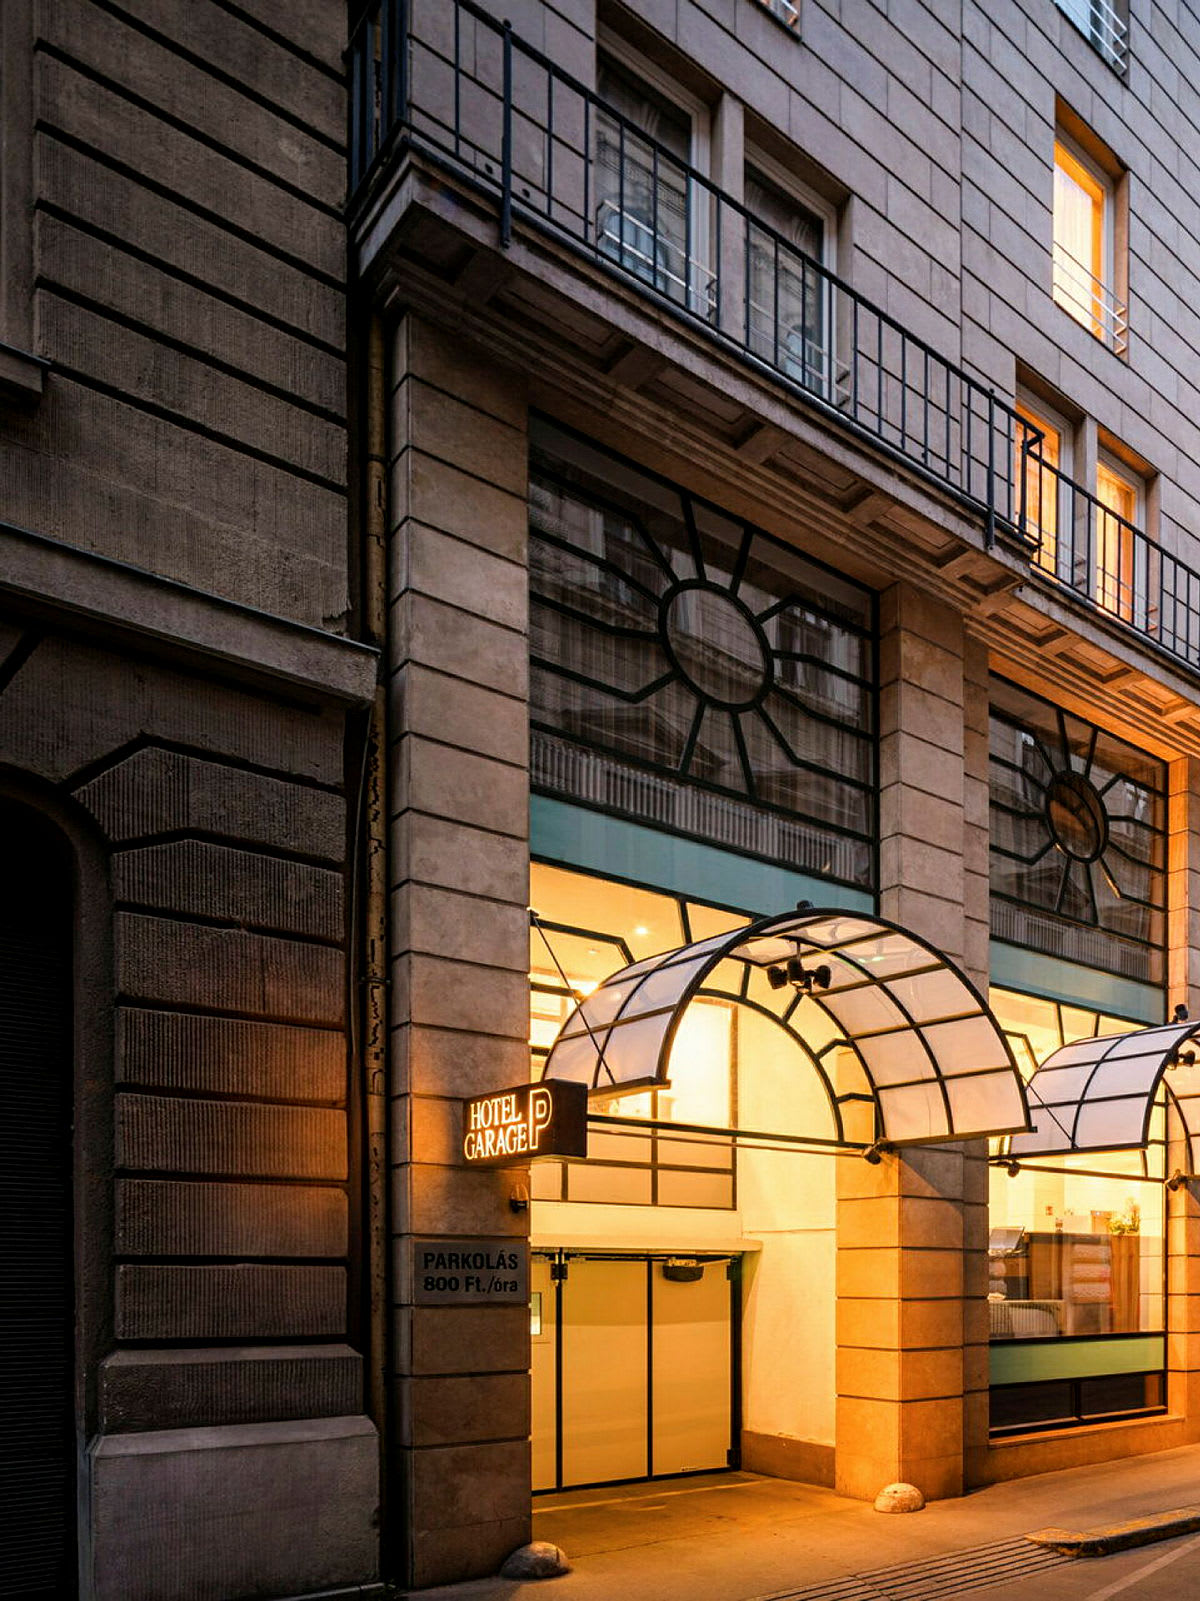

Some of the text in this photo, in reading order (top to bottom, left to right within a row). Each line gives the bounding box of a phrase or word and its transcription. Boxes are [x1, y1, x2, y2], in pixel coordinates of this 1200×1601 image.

[470, 1094, 522, 1130] HOTEL
[529, 1088, 553, 1149] P
[464, 1123, 528, 1160] GARAGE
[423, 1249, 518, 1270] PARKOLÁS
[423, 1276, 460, 1291] 800
